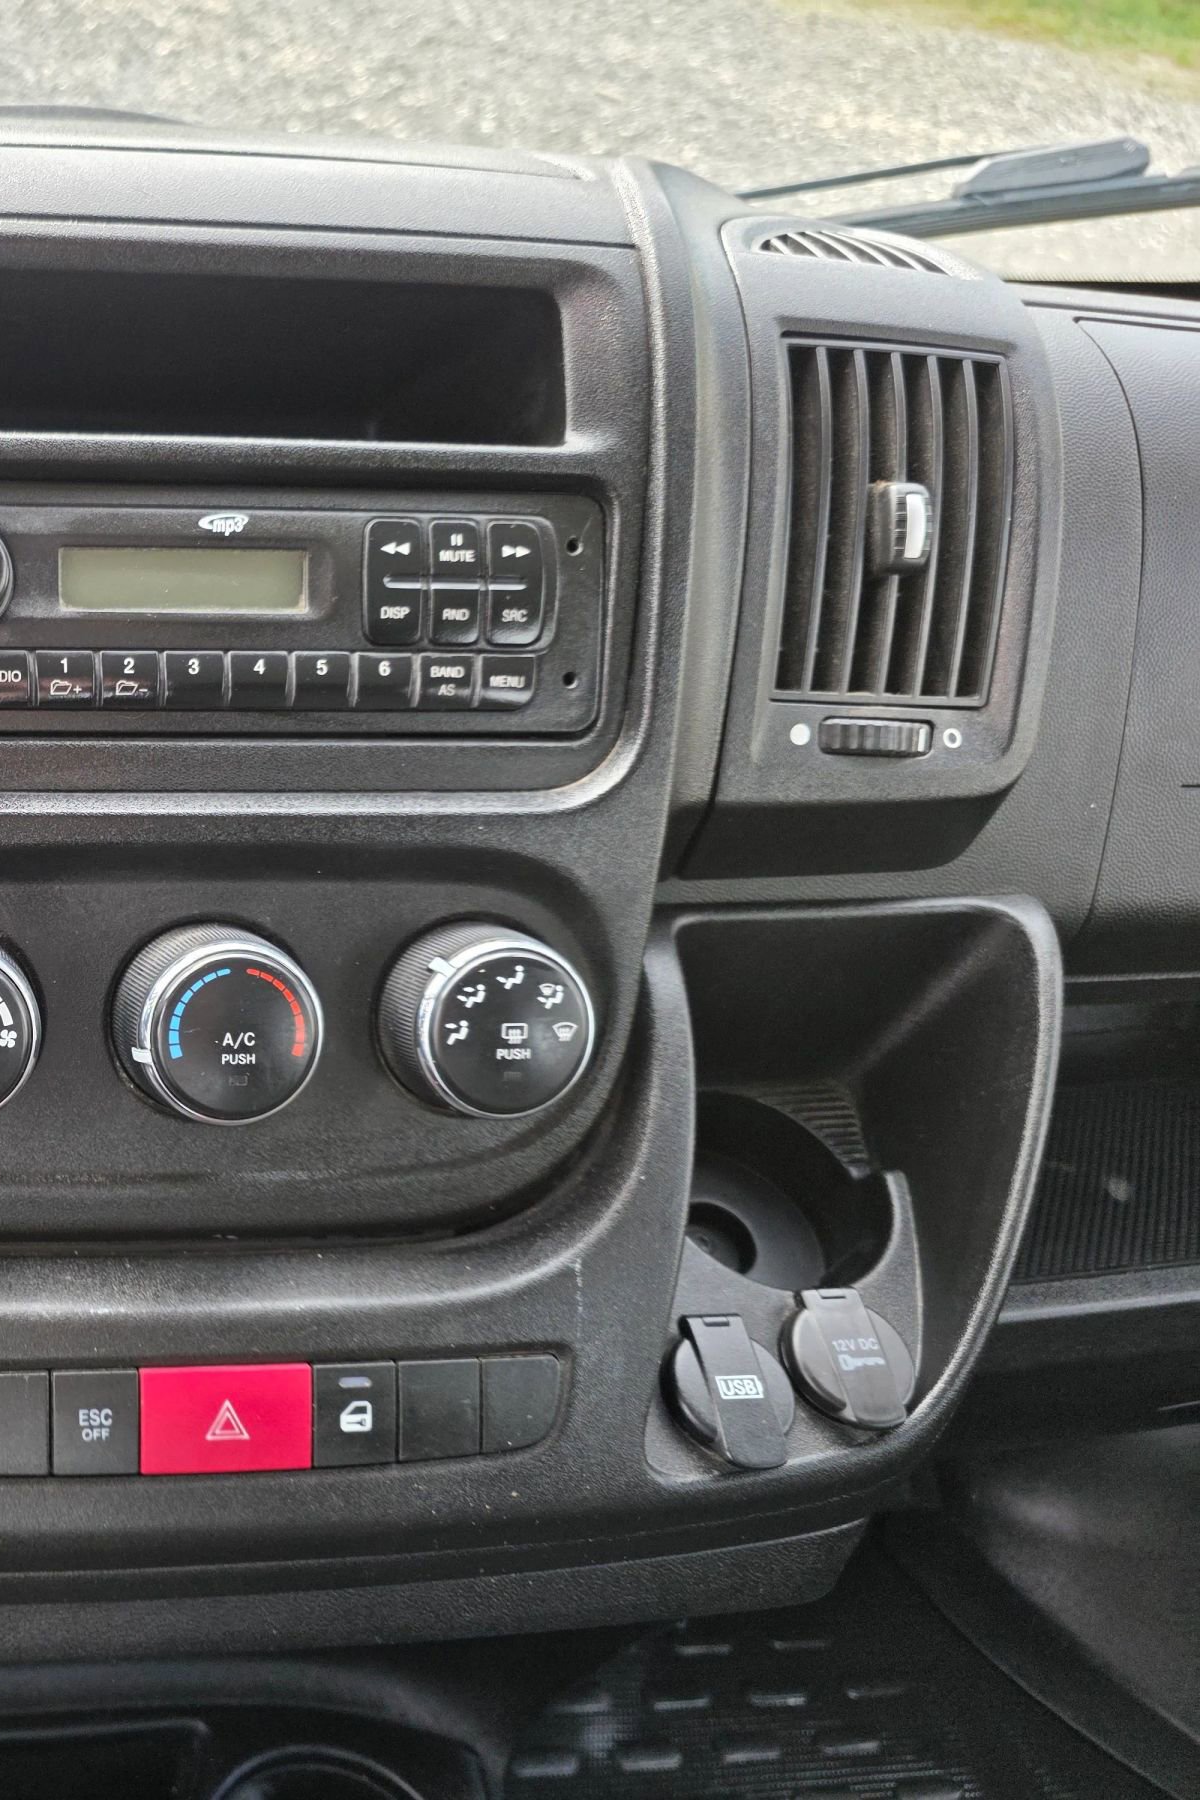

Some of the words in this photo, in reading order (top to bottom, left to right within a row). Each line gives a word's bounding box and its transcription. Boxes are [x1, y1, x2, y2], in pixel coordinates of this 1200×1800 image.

[212, 518, 243, 536] mp3
[439, 549, 476, 563] MUTE
[380, 606, 410, 619] DISP
[442, 608, 470, 621] RND
[502, 609, 528, 623] SRC
[59, 658, 68, 674] 1
[123, 658, 135, 674] 2
[188, 658, 200, 675] 3
[253, 660, 265, 675] 4
[316, 659, 328, 676] 5
[378, 660, 391, 677] 6
[430, 665, 465, 679] BAND
[490, 675, 526, 689] MENU
[437, 684, 456, 697] AS
[222, 1031, 256, 1050] A/C
[221, 1053, 256, 1065] PUSH
[495, 1047, 532, 1060] PUSH
[832, 1338, 855, 1352] 12V
[859, 1337, 879, 1351] DC
[720, 1379, 756, 1396] USB
[79, 1408, 113, 1426] ESC
[82, 1428, 110, 1442] OFF
